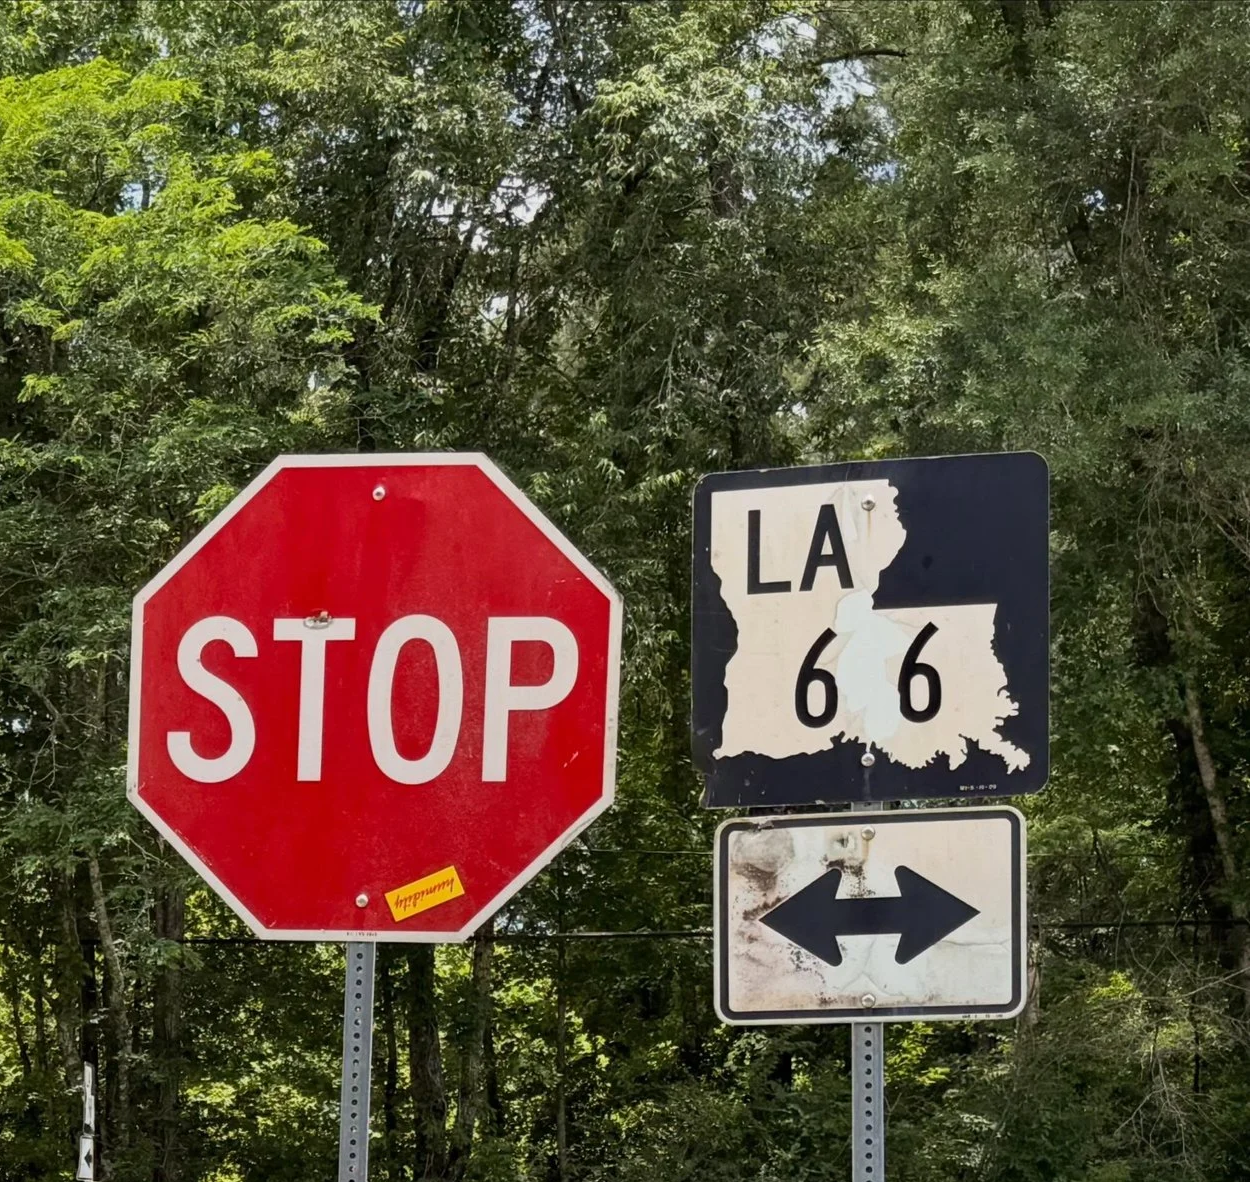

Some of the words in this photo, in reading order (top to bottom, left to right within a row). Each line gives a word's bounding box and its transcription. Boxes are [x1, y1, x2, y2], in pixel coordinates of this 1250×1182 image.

[747, 503, 854, 595] LA
[166, 614, 579, 784] STOP
[394, 877, 454, 912] humidity
